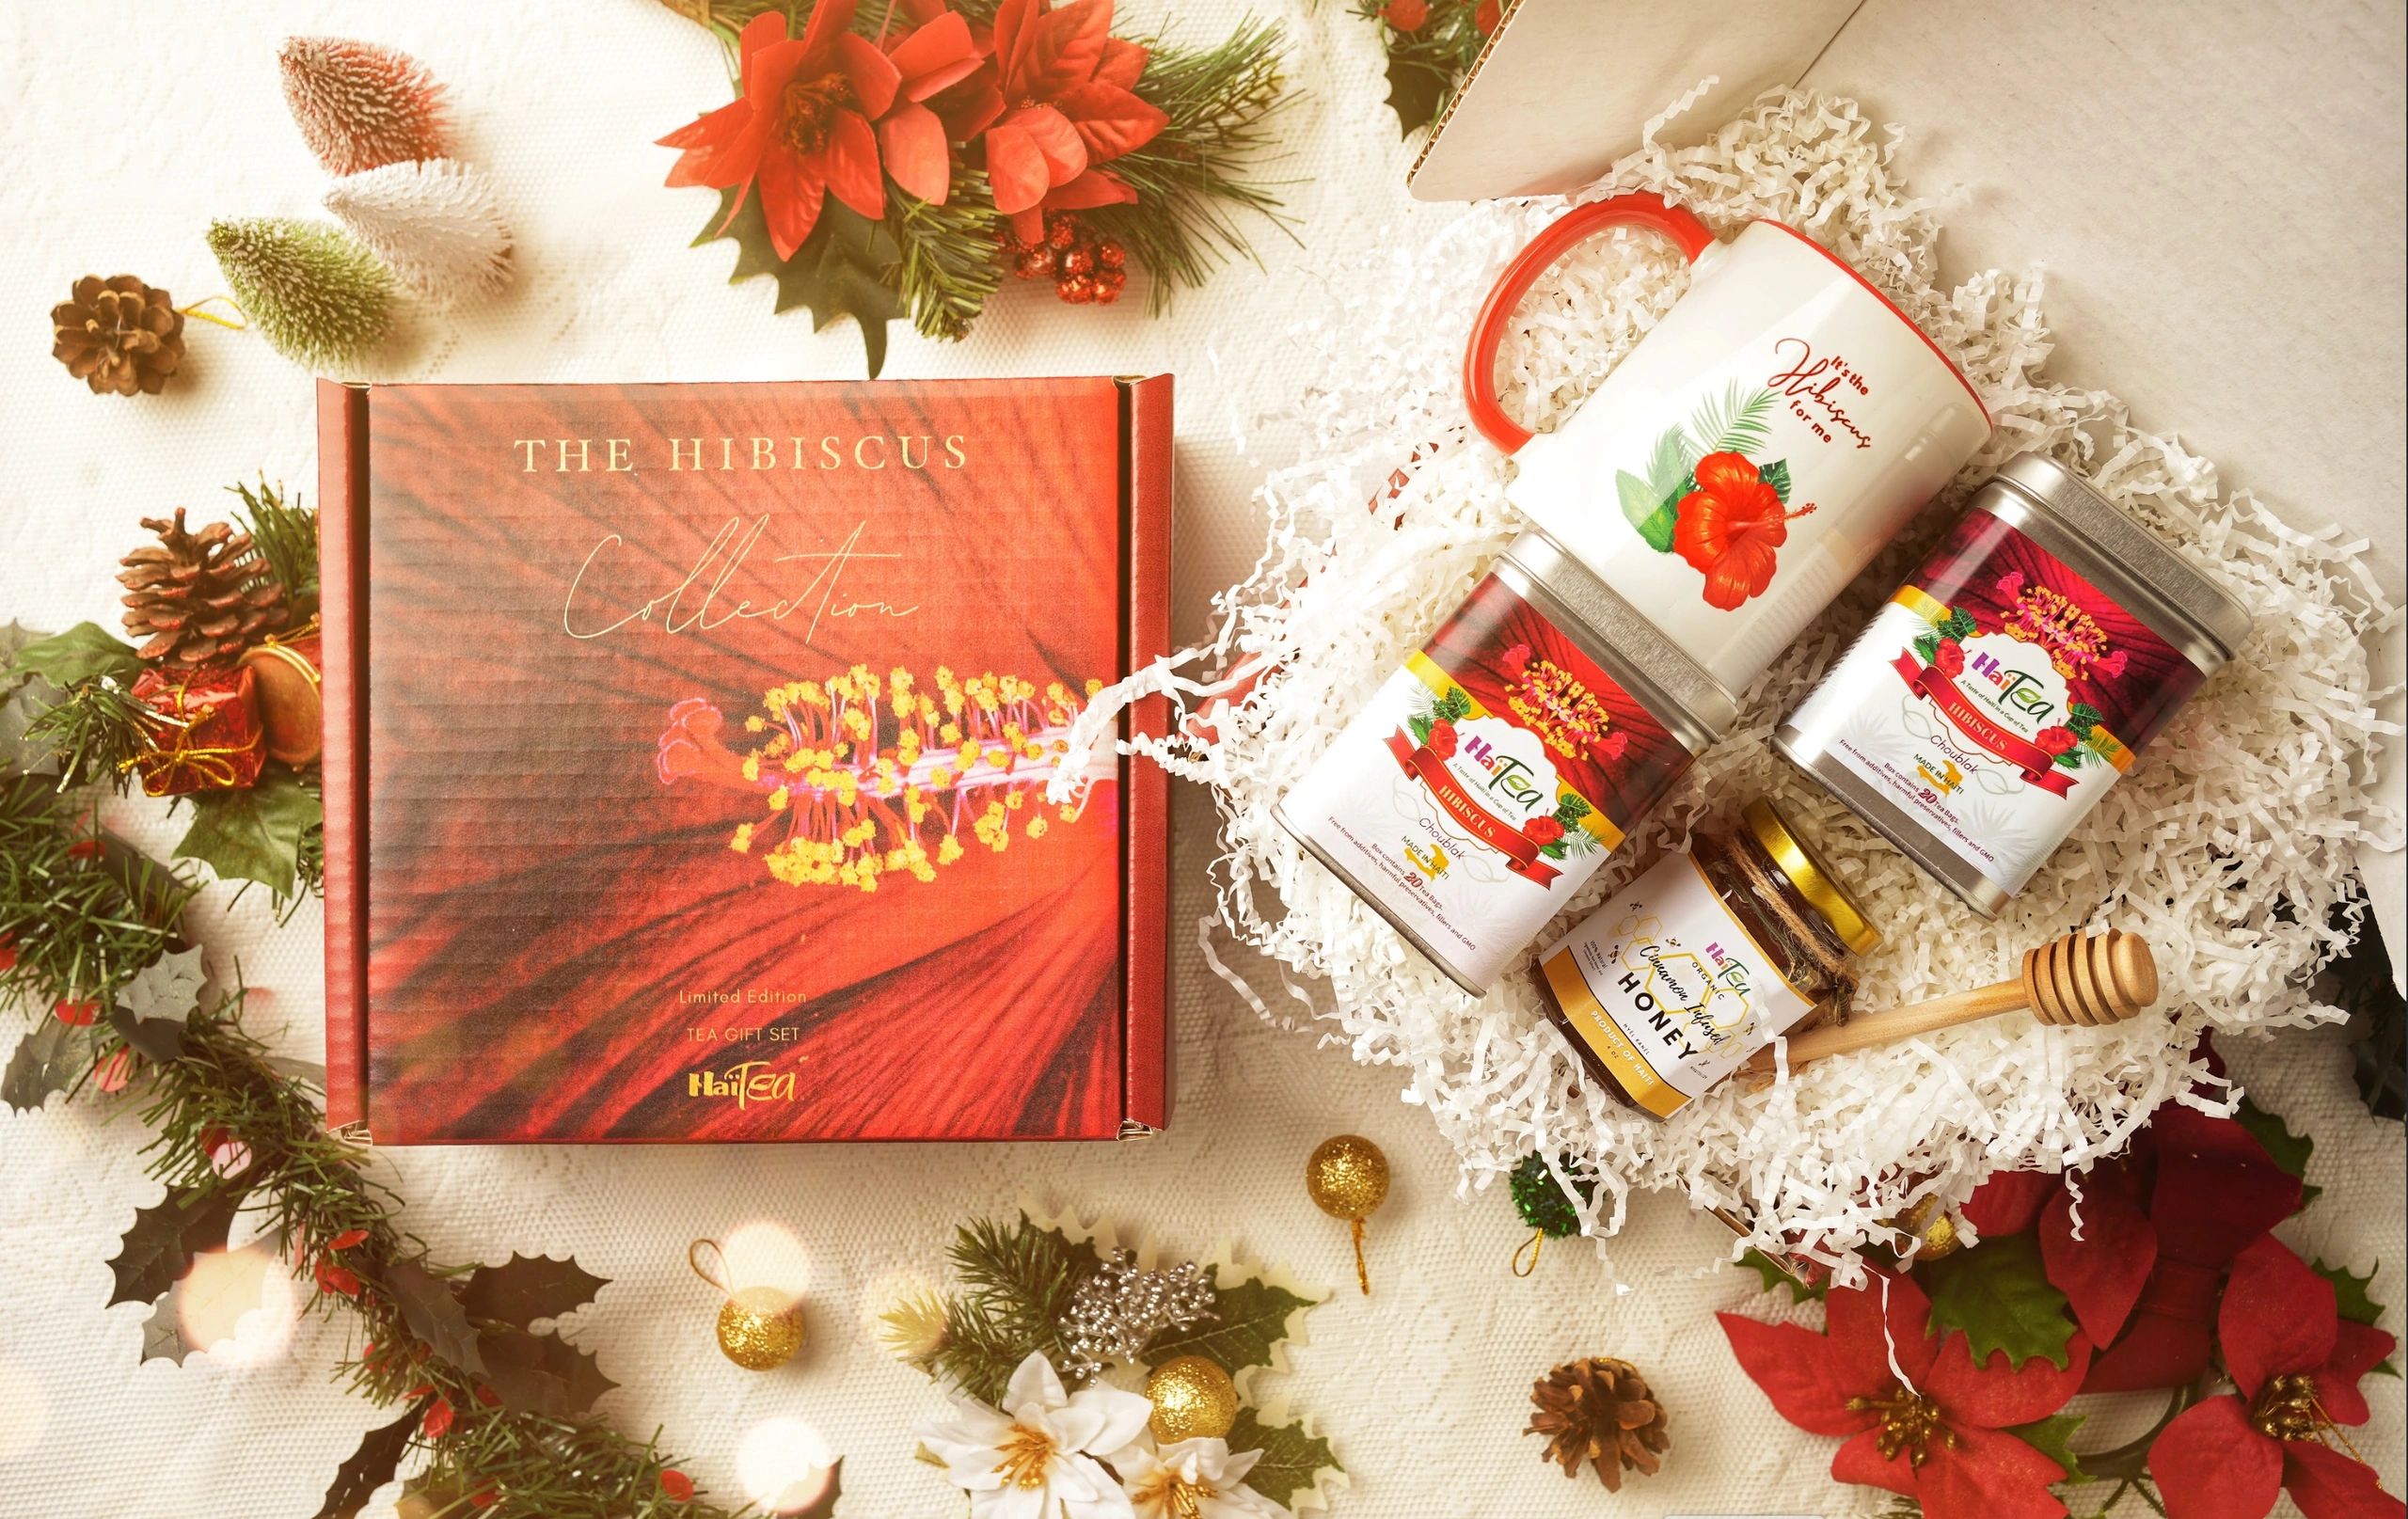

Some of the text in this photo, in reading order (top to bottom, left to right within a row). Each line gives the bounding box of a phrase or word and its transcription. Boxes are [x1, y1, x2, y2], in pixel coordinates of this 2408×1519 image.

[1767, 337, 1871, 449] Hibiscus
[1830, 356, 1869, 396] It's the
[1789, 400, 1831, 443] for me
[514, 435, 967, 472] THE HIBISCUS
[564, 513, 919, 644] Collection
[1948, 702, 2008, 751] HIBISCUS
[2003, 712, 2014, 721] Cup
[2019, 723, 2028, 733] Tea
[1912, 753, 1936, 772] MADE
[1934, 769, 1944, 779] IN
[1930, 735, 1978, 774] Choublak
[1438, 784, 1496, 837] HIBISCUS
[1840, 739, 1994, 862] Free from additives, harmful preservatives, fillers and GMO
[1884, 763, 1895, 773] Box
[1895, 772, 1920, 792] contains
[1918, 788, 1938, 803] 20
[1934, 801, 1944, 812] Tea
[1401, 835, 1423, 856] MADE
[1421, 853, 1431, 863] IN
[1418, 817, 1465, 860] Choublak
[1328, 815, 1476, 951] Free from additives, harmful preservatives, fillers and GMO
[1371, 843, 1383, 855] Box
[1382, 853, 1405, 876] contains
[1403, 872, 1423, 888] 20
[1418, 886, 1430, 897] Tea
[679, 989, 807, 1005] Limited Edition
[1640, 945, 1732, 1046] Cinnamon Infused
[1692, 961, 1725, 1000] ORGANIC
[687, 1027, 800, 1042] TEA GIFT SET
[1590, 1009, 1624, 1049] PRODUCT
[1622, 1049, 1635, 1063] OF
[1617, 972, 1699, 1060] HONEY
